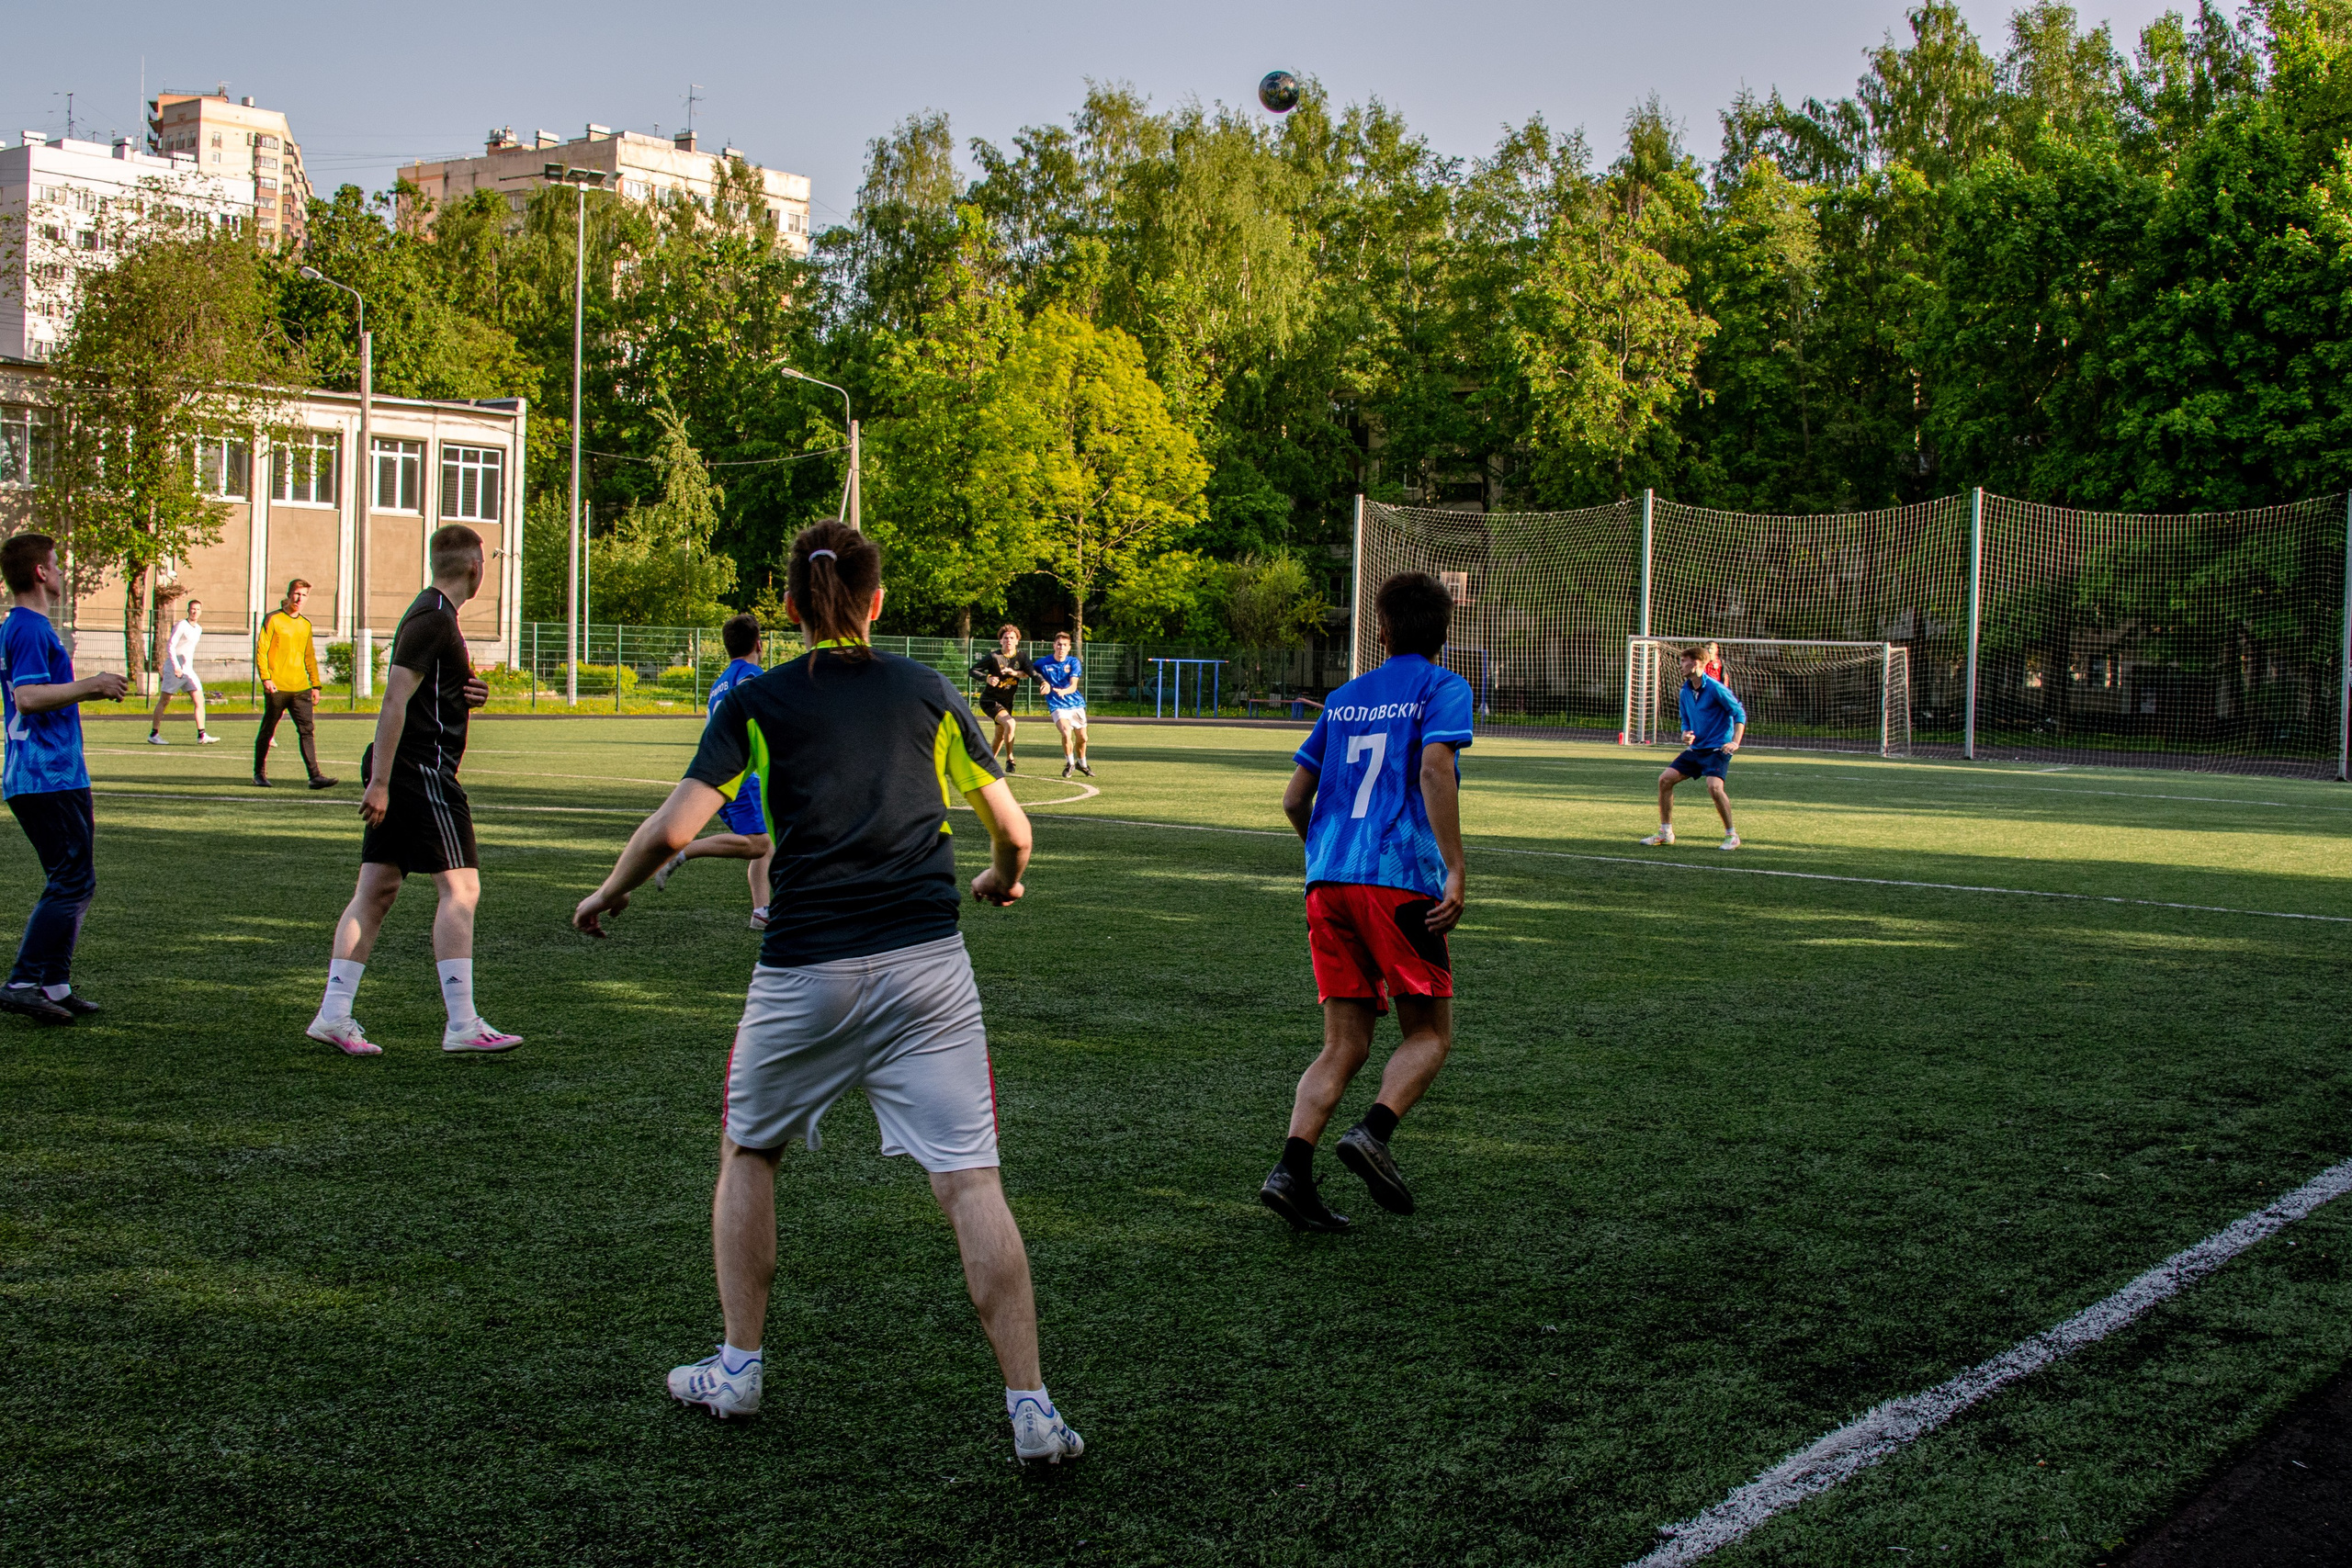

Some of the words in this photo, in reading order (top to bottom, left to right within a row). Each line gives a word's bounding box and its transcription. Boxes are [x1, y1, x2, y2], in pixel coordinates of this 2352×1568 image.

[1346, 733, 1387, 818] 7
[749, 1365, 759, 1392] COPA
[1024, 1404, 1035, 1432] COPA
